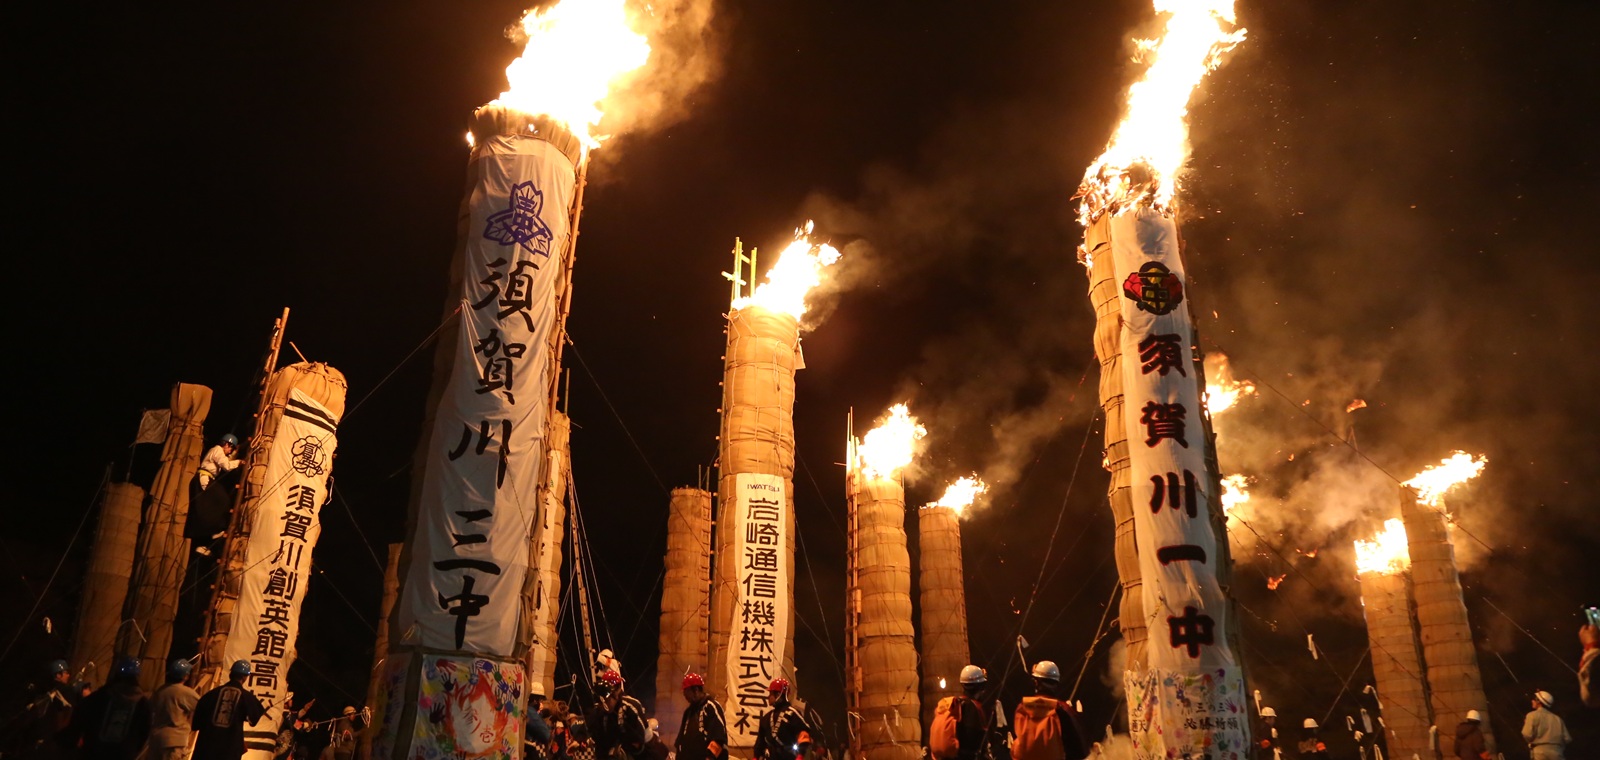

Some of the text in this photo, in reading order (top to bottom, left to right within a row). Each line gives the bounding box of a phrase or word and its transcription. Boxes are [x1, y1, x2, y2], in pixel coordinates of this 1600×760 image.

[433, 257, 540, 649] 須賀川三中
[747, 484, 780, 492] IWATSU
[1138, 333, 1214, 658] 須賀川一中
[734, 497, 780, 735] 岩崎通信機株式会社
